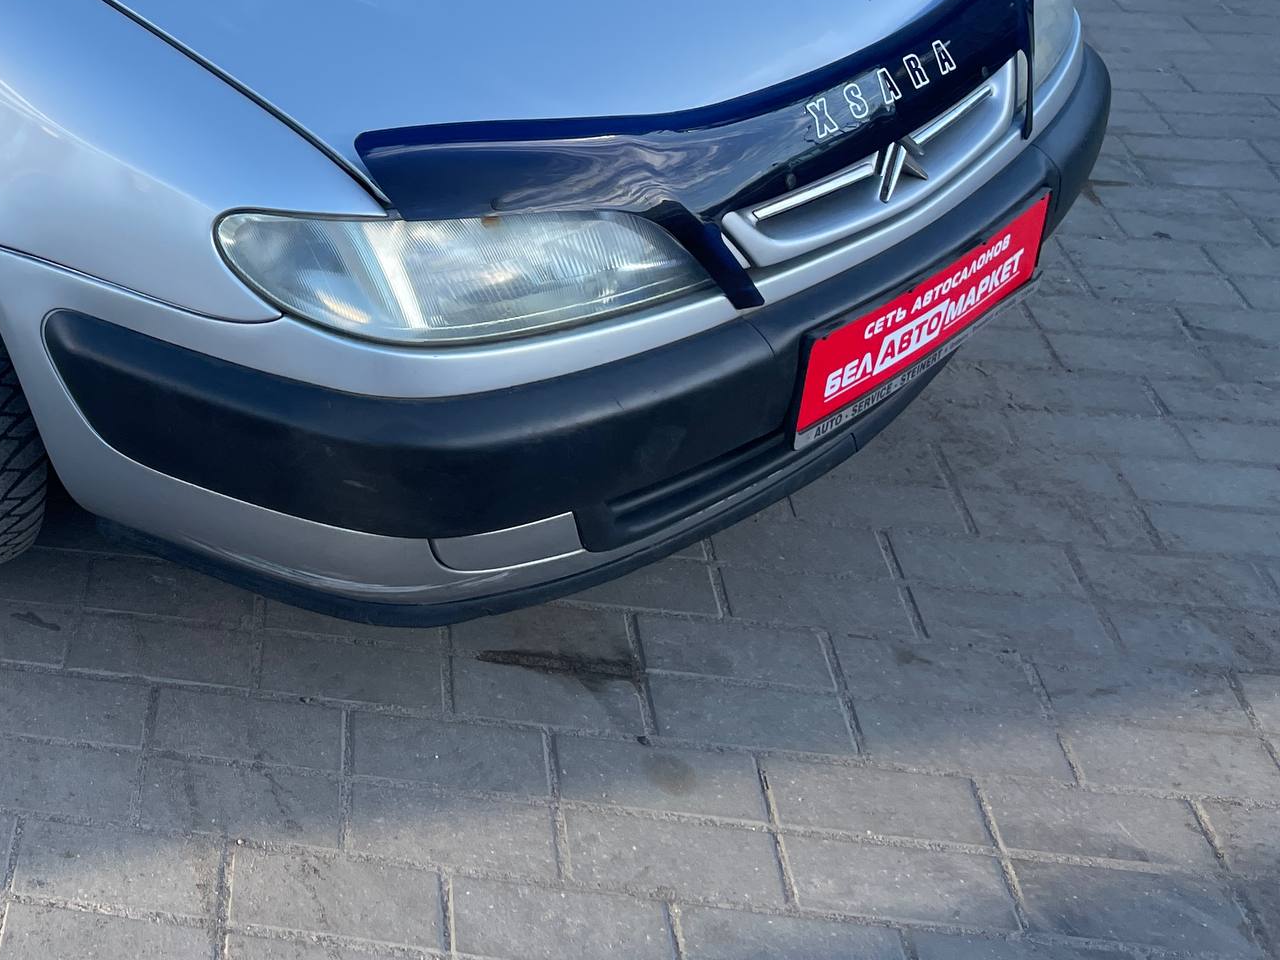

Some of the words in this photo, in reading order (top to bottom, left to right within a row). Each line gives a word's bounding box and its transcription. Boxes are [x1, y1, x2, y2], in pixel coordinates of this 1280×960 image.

[806, 39, 957, 139] XSARA
[864, 307, 907, 340] СЕТЬ
[910, 233, 1012, 314] АВТОСАЛОНОВ
[813, 414, 843, 439] AUTO
[851, 382, 894, 417] SERVICE
